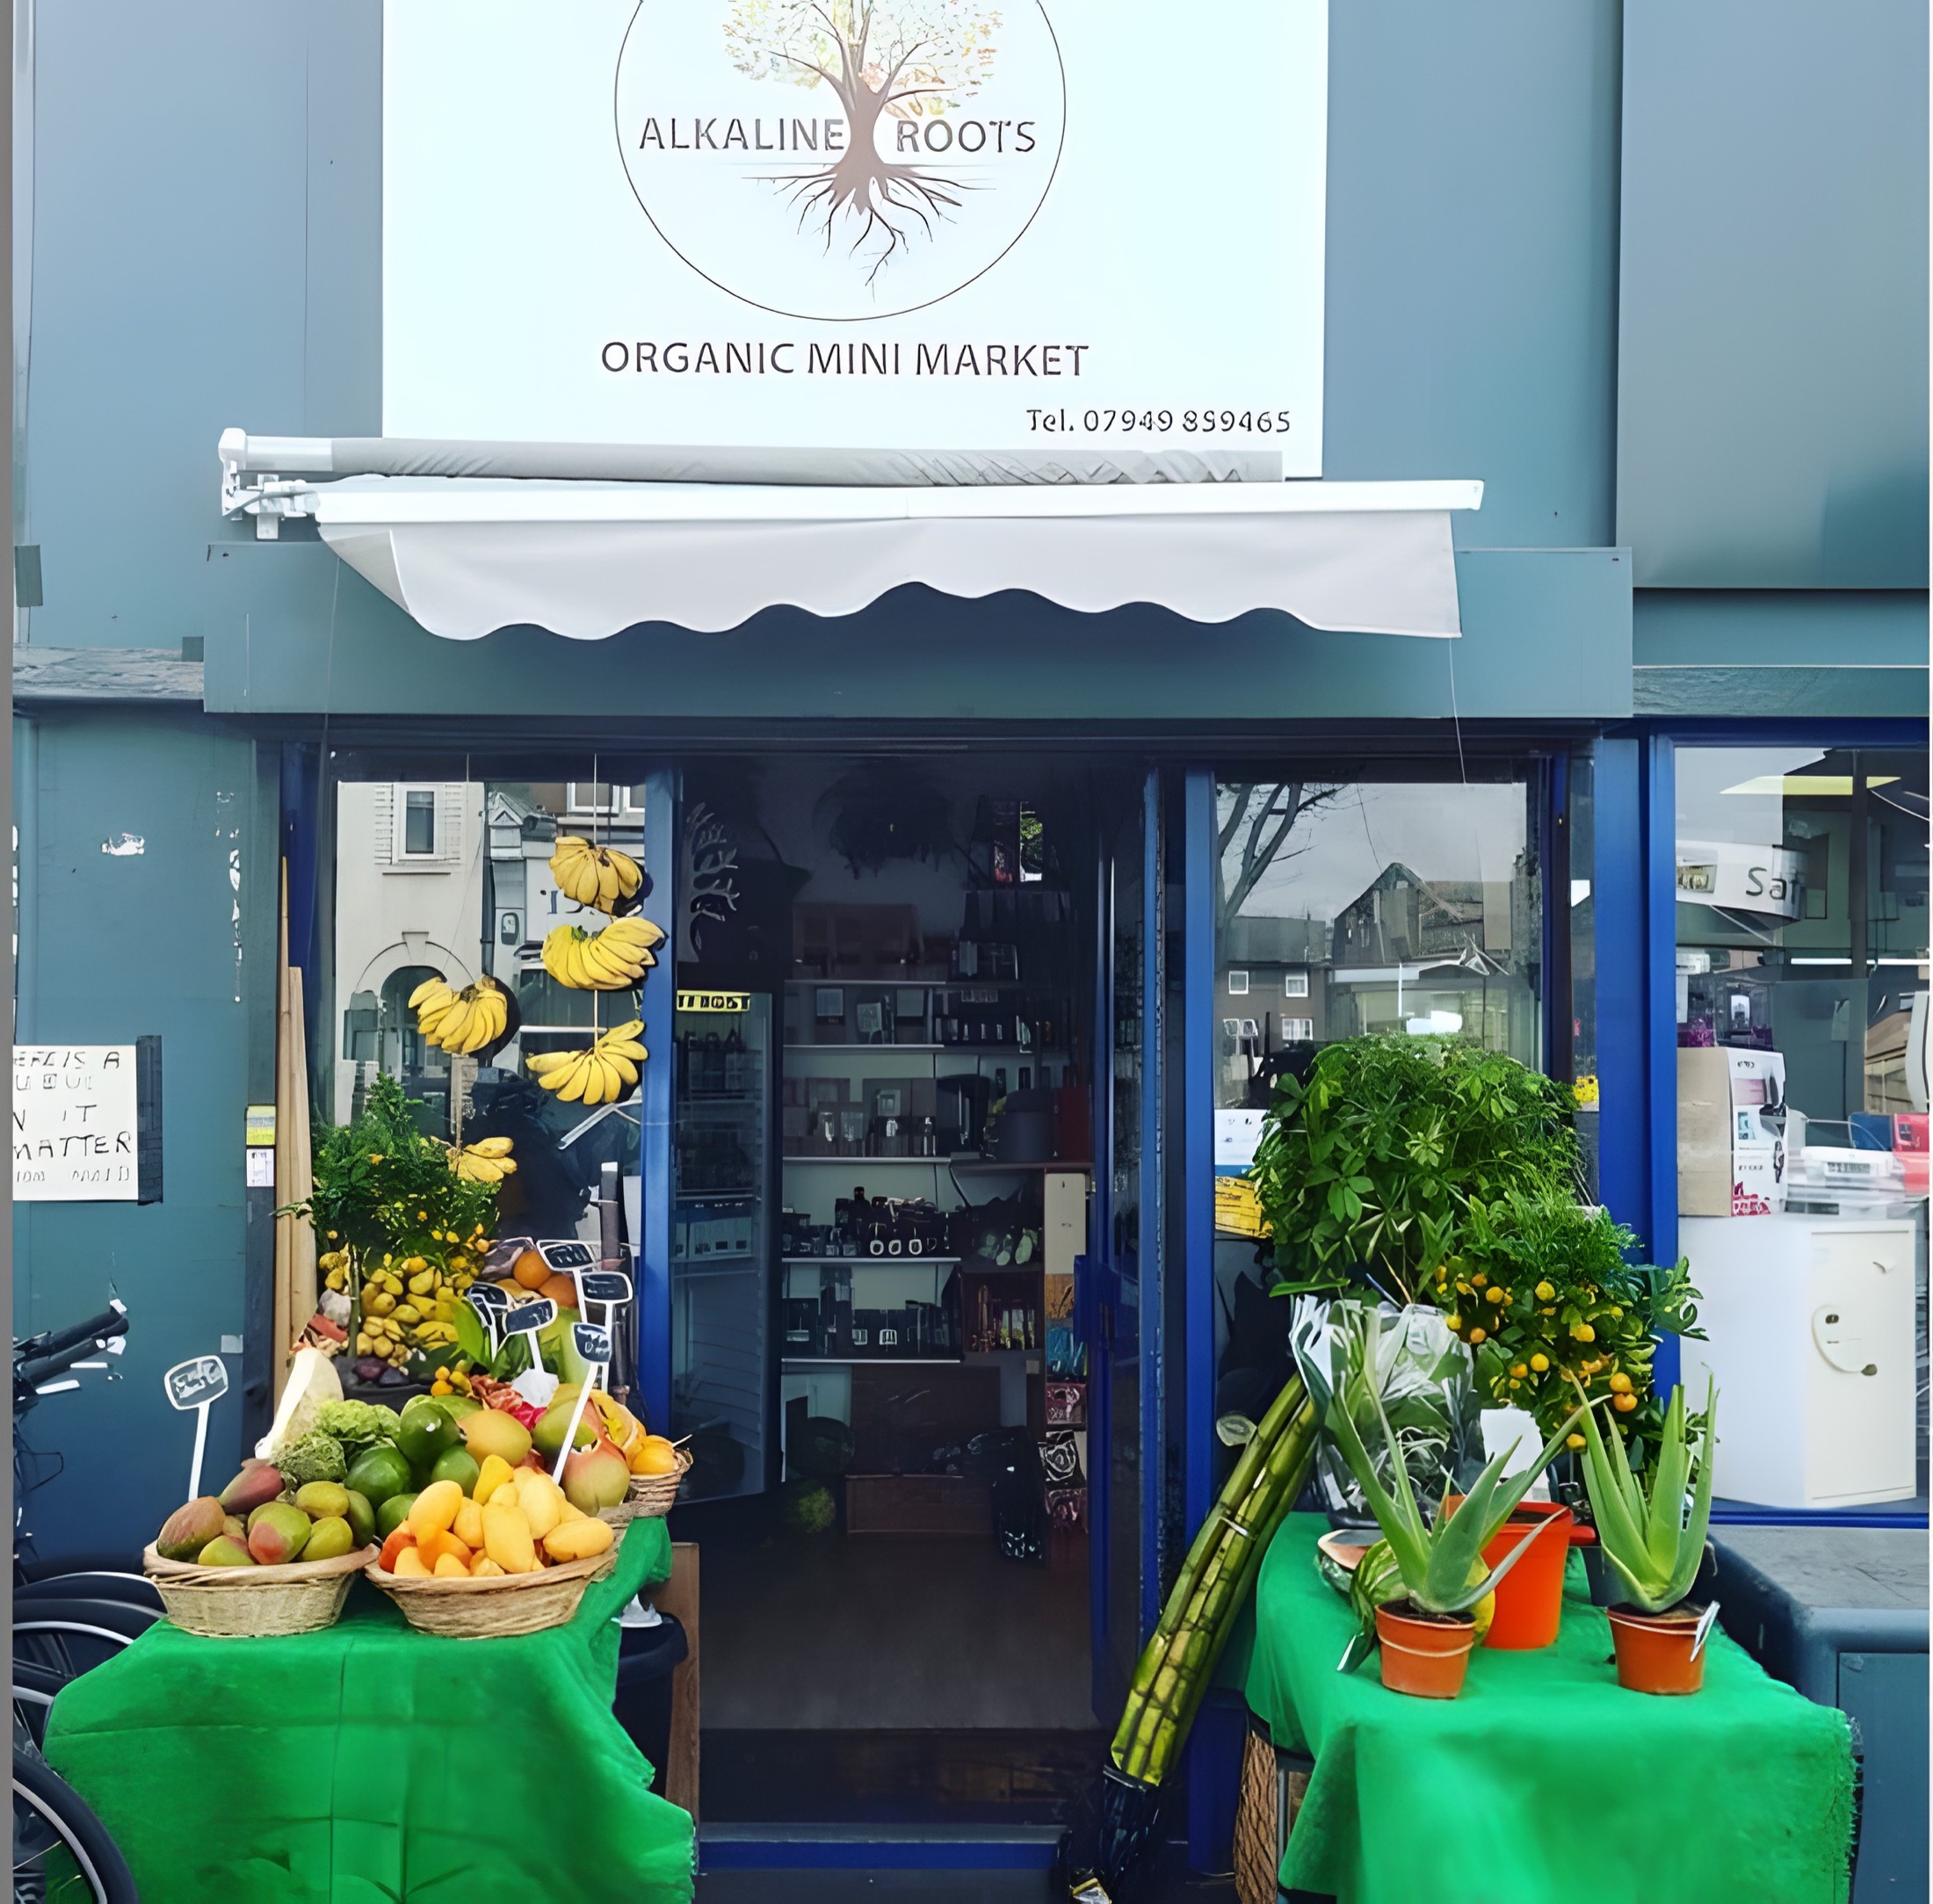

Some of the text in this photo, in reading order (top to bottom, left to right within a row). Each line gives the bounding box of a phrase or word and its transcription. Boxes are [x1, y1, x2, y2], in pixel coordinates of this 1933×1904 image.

[639, 118, 1036, 153] ALKALINE ROOTS
[601, 342, 1090, 377] ORGANIC MINI MARKET
[1025, 409, 1075, 432] Tel.
[1083, 409, 1173, 432] 07949
